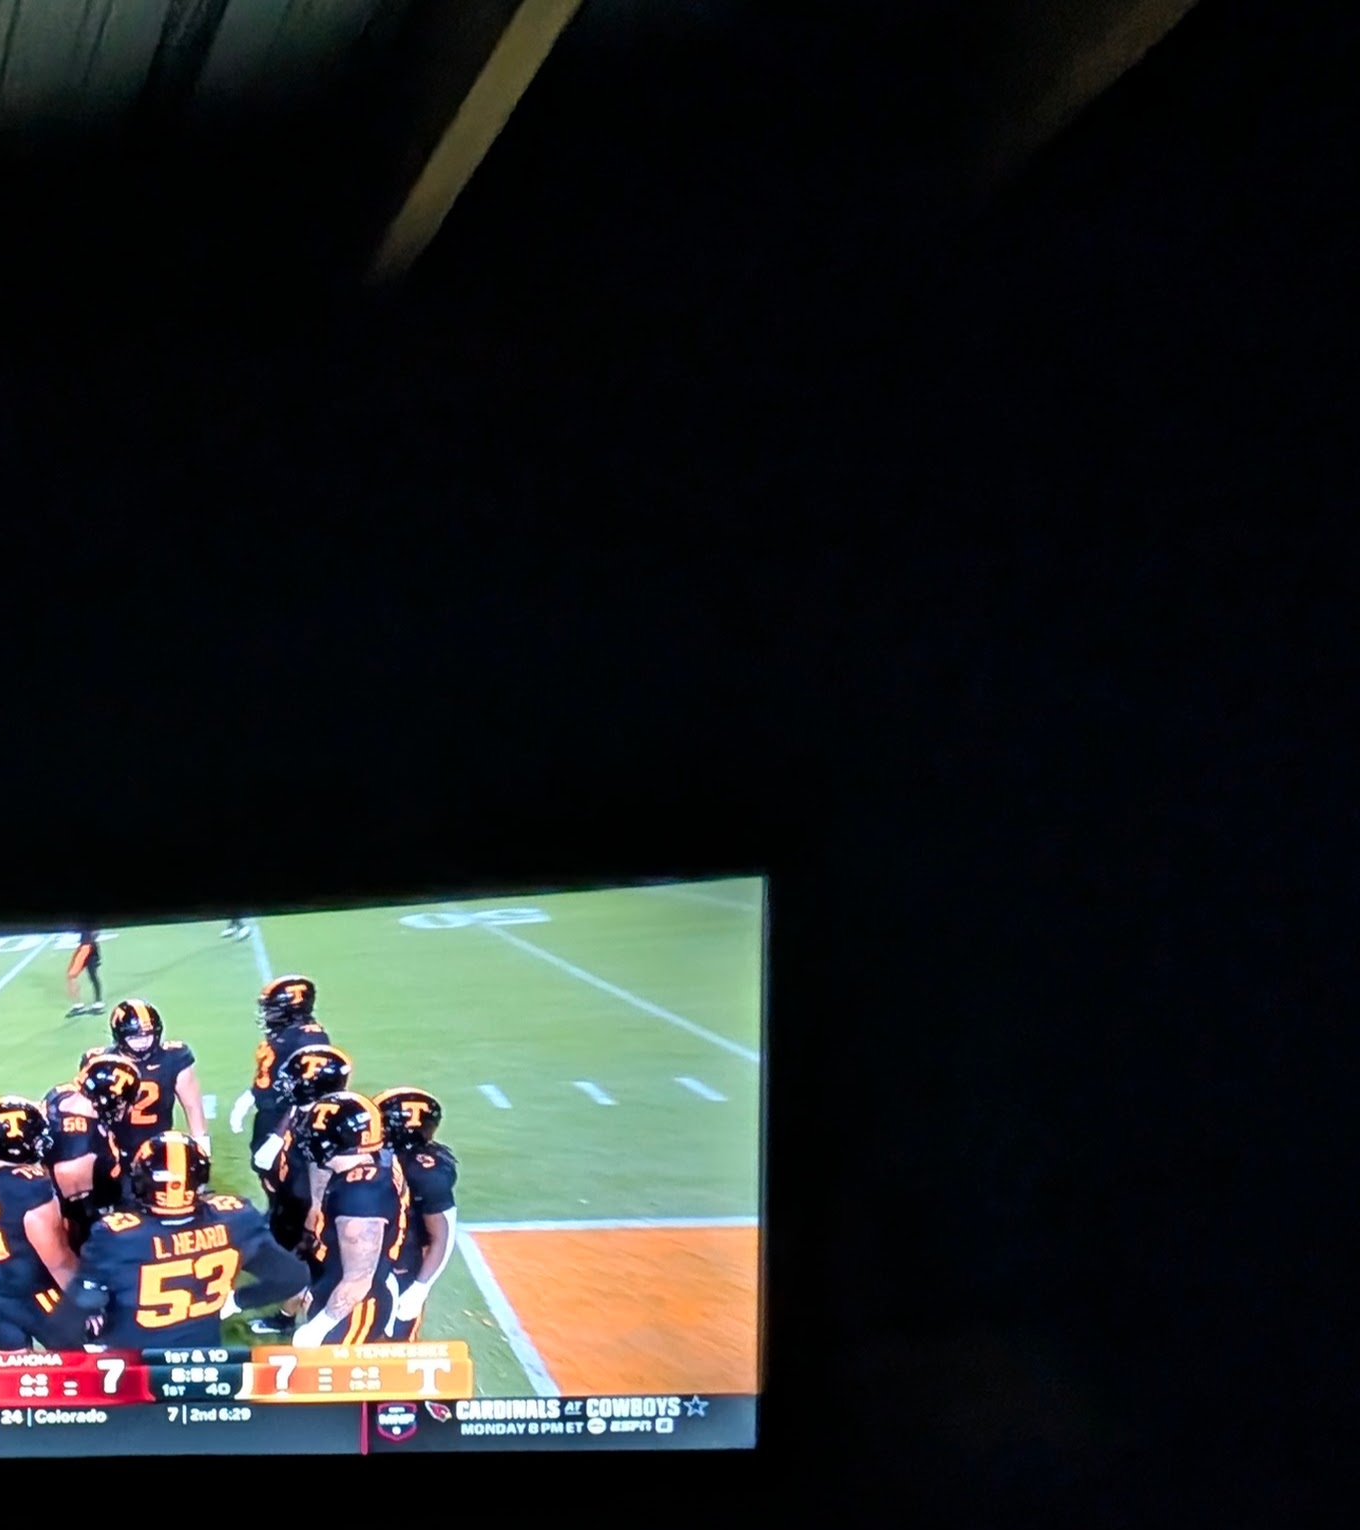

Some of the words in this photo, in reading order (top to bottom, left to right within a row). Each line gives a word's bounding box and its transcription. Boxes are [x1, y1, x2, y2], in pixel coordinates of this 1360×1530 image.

[286, 984, 307, 1005] T
[301, 1054, 328, 1080] T
[109, 1067, 135, 1096] T
[313, 1102, 340, 1131] T
[401, 1101, 430, 1128] T
[171, 1223, 229, 1256] HEARD
[135, 1247, 241, 1330] 53
[191, 1349, 205, 1363] &
[208, 1349, 229, 1363] 10
[96, 1358, 126, 1394] 7
[268, 1355, 298, 1391] 7
[406, 1358, 452, 1396] T
[205, 1382, 231, 1396] 40
[0, 1409, 24, 1425] 24
[34, 1408, 108, 1425] Colorado
[167, 1406, 179, 1422] 7
[190, 1407, 217, 1422] 2nd
[455, 1399, 561, 1421] CARDINALS
[564, 1401, 584, 1415] AT
[586, 1396, 682, 1419] COWBOYS
[461, 1422, 526, 1436] MONDAY
[540, 1421, 564, 1435] PM
[565, 1420, 584, 1434] ET
[609, 1420, 653, 1433] ESPN
